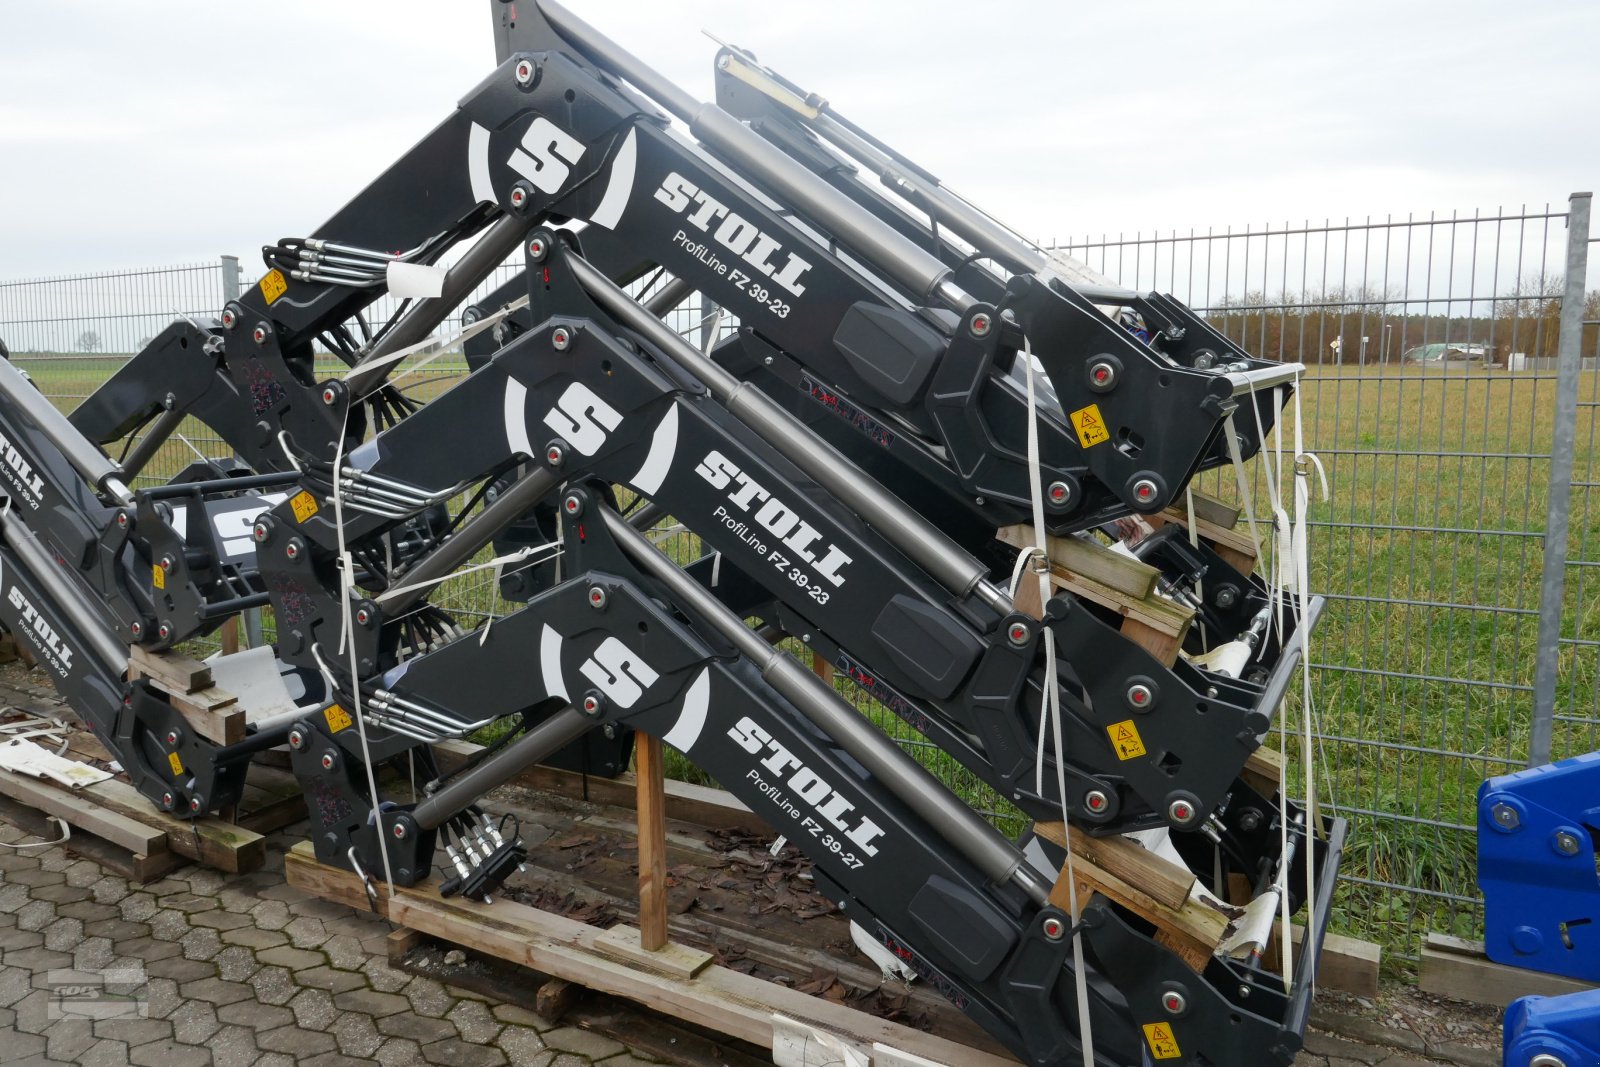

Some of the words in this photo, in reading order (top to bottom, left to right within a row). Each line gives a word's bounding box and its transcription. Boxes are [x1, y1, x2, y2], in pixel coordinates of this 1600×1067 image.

[653, 171, 813, 298] STOLL
[672, 229, 728, 275] ProfiLine
[727, 268, 751, 290] FZ
[748, 283, 791, 319] 39-23
[694, 450, 854, 588] STOLL
[712, 505, 767, 555] ProfiLine
[766, 550, 791, 573] FZ
[787, 567, 830, 605] 39-23
[7, 585, 73, 670] STOLL
[18, 618, 42, 649] ProfiLine
[726, 716, 886, 858] STOLL
[745, 769, 801, 820] ProfiLine
[800, 816, 824, 838] FZ
[821, 834, 865, 870] 39-27
